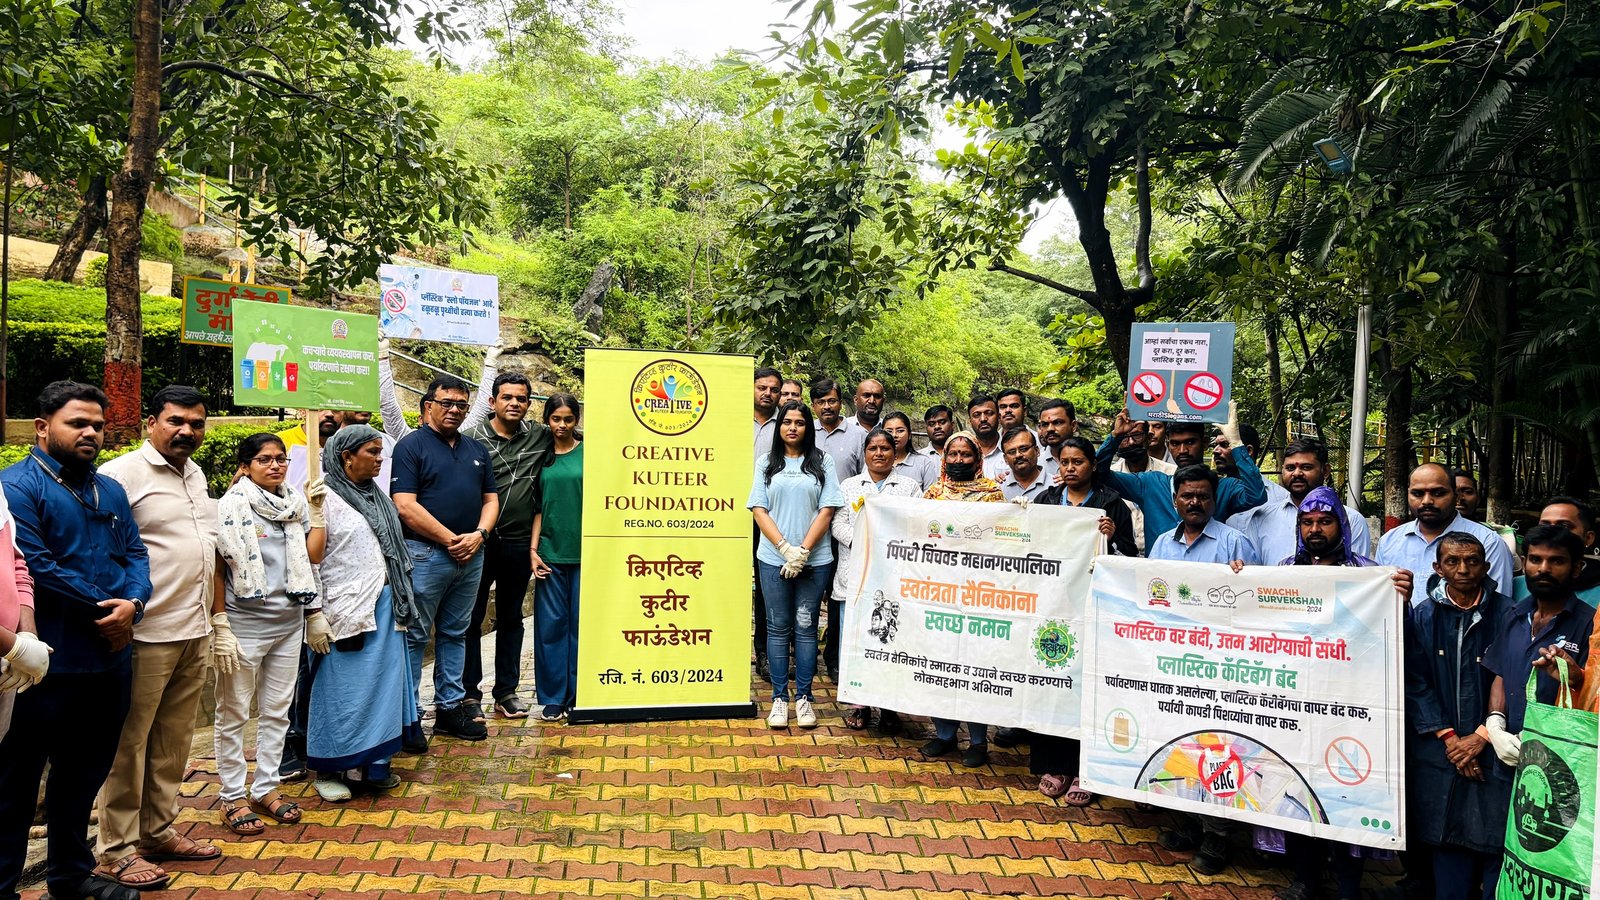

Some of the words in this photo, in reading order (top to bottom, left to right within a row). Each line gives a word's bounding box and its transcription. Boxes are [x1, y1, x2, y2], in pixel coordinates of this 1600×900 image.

[644, 398, 692, 413] CREATIVE
[622, 445, 715, 462] CREATIVE
[633, 471, 709, 486] KUTEER
[605, 495, 734, 512] FOUNDATION
[624, 519, 665, 528] REG.NO.
[667, 519, 715, 529] 603/2024
[626, 554, 705, 581] क्रिएटिव्ह
[886, 540, 920, 562] पिंपरी
[921, 543, 958, 567] चिंचवड
[961, 552, 1062, 577] महानगरपालिका
[640, 588, 690, 618] कुटीर
[900, 576, 958, 604] स्वतंत्रता
[961, 579, 1038, 614] सैनिकांना
[1257, 586, 1299, 597] SWACHH
[1257, 595, 1323, 606] SURVEKSHAN
[622, 623, 713, 647] फाऊंडेशन
[924, 610, 966, 634] स्वच्छ
[967, 616, 1012, 641] नमन
[1113, 620, 1166, 642] प्लास्टिक
[1169, 627, 1186, 645] वर
[1188, 626, 1213, 650] बंदी,
[1216, 631, 1245, 651] उत्तम
[1249, 632, 1312, 658] आरोग्याची
[1315, 638, 1351, 661] संधी.
[598, 668, 627, 685] रजि.
[631, 668, 646, 684] नं.
[651, 669, 723, 684] 603/2024
[864, 648, 889, 663] स्वतंत्र
[929, 659, 961, 674] स्मारक
[963, 666, 970, 675] व
[972, 666, 998, 681] उद्याने
[999, 670, 1027, 684] स्वच्छ
[1028, 674, 1074, 690] करण्याचे
[1157, 653, 1218, 680] प्लास्टिक
[1221, 656, 1272, 687] कॅरिबॅग
[1275, 663, 1298, 690] बंद
[913, 670, 970, 691] लोकसहभाग
[971, 680, 1013, 698] अभियान
[1104, 674, 1148, 692] पर्यावरणास
[1150, 681, 1174, 696] घातक
[1175, 685, 1218, 702] असलेल्या,
[1221, 689, 1257, 706] प्लास्टिक
[1259, 691, 1302, 712] कॅरीबॅगचा
[1304, 700, 1328, 716] वापर
[1330, 701, 1345, 717] बंद
[1348, 706, 1372, 722] करू,
[1158, 699, 1184, 715] पर्यायी
[1186, 703, 1211, 719] कापडी
[1213, 708, 1253, 725] पिशव्यांचा
[1255, 714, 1277, 729] वापर
[1211, 771, 1235, 791] BAG
